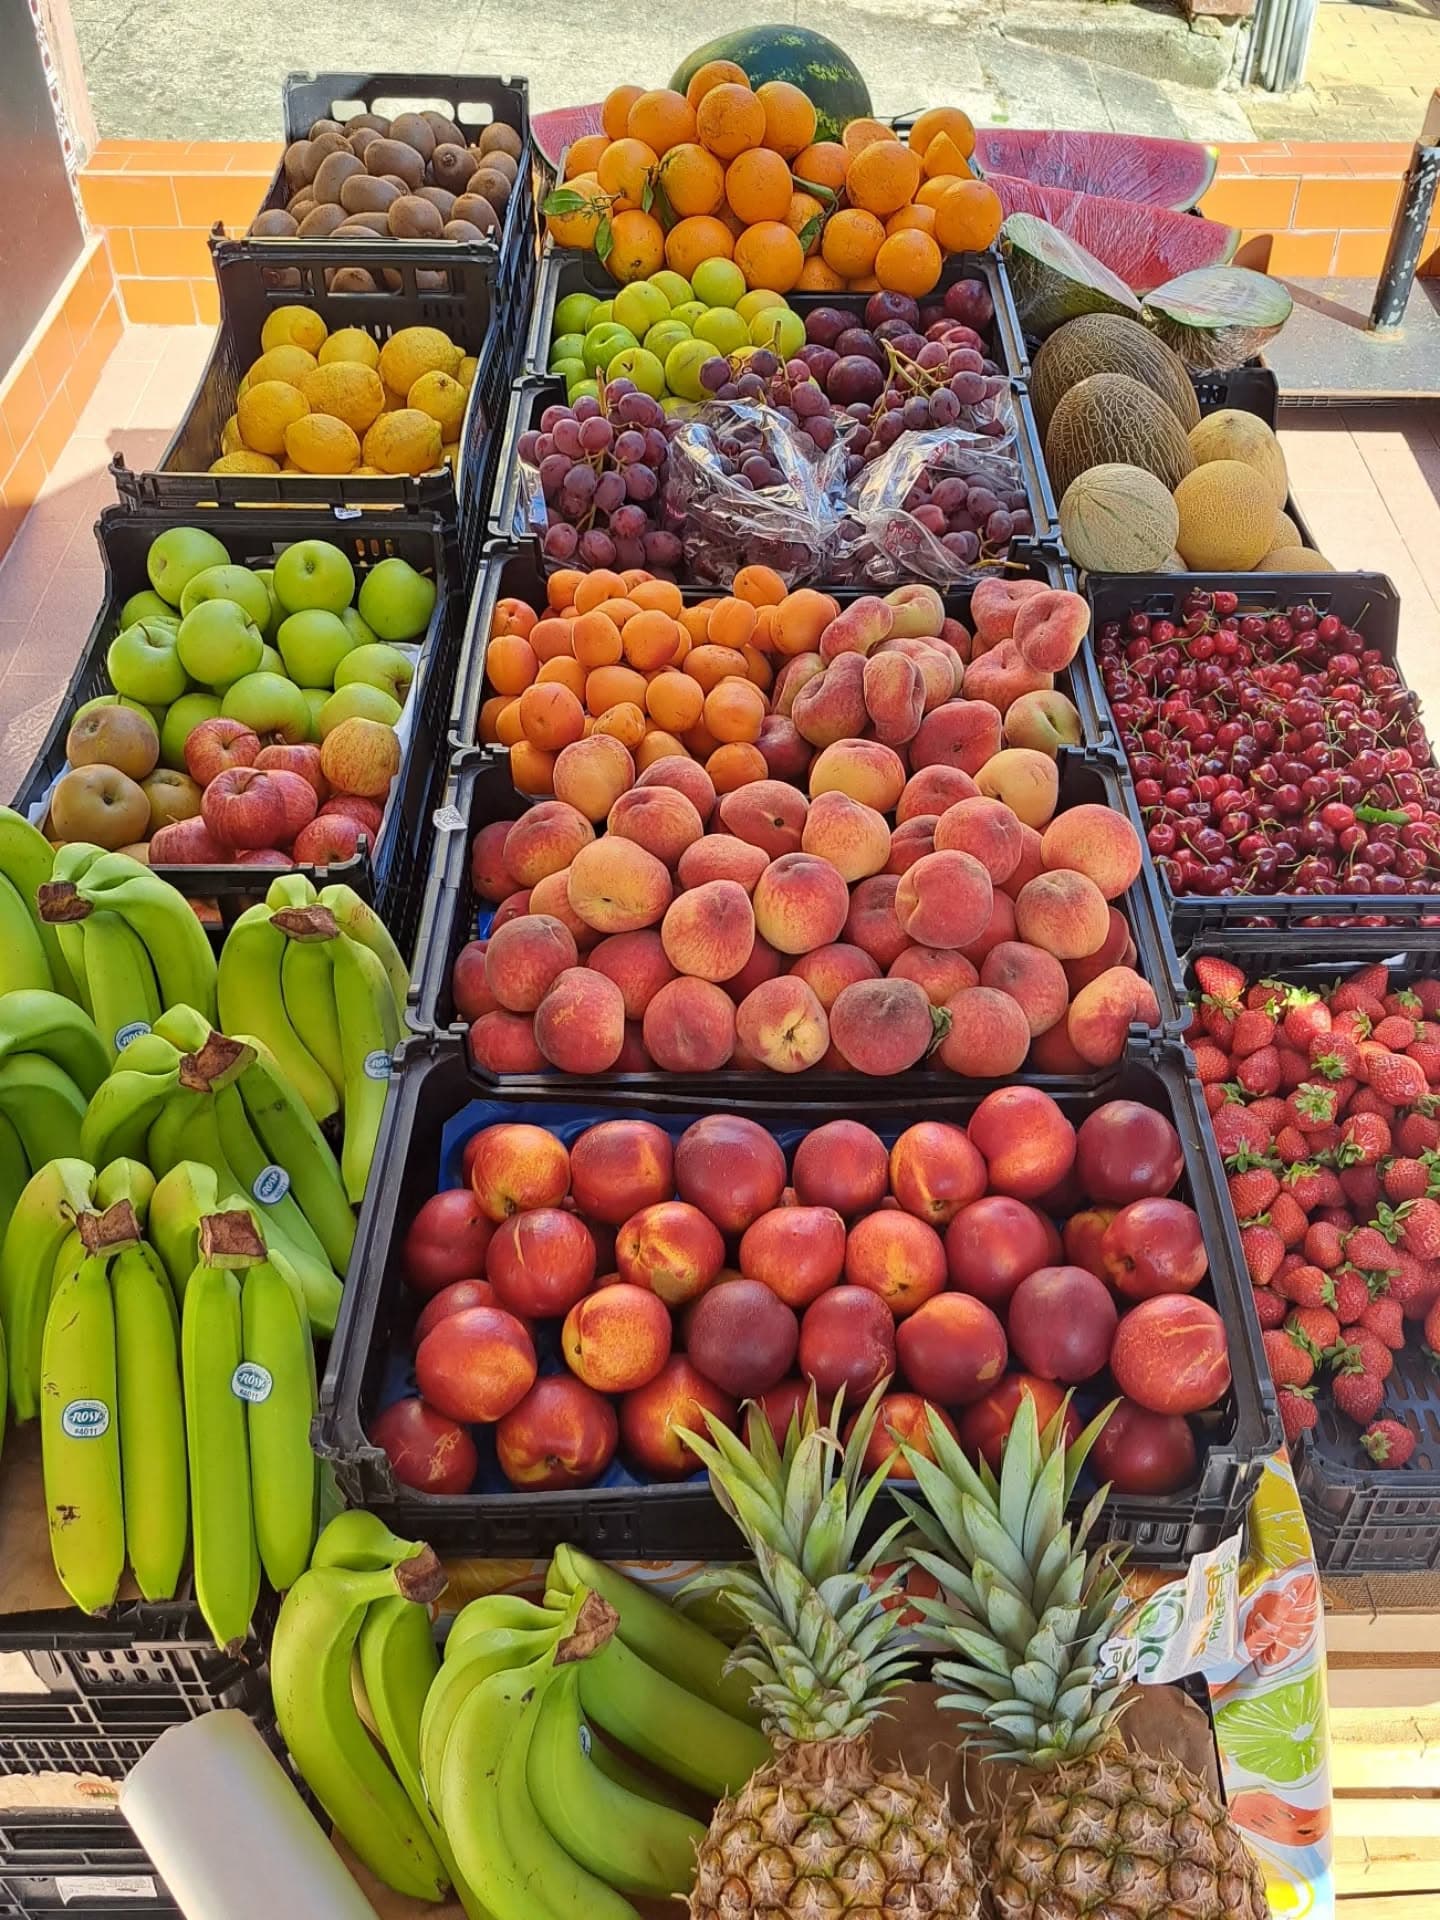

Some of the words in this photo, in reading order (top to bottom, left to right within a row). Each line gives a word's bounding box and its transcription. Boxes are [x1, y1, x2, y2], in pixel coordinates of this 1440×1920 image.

[239, 1373, 265, 1388] ROSY
[72, 1410, 100, 1423] ROSY
[1102, 1646, 1122, 1680] Del
